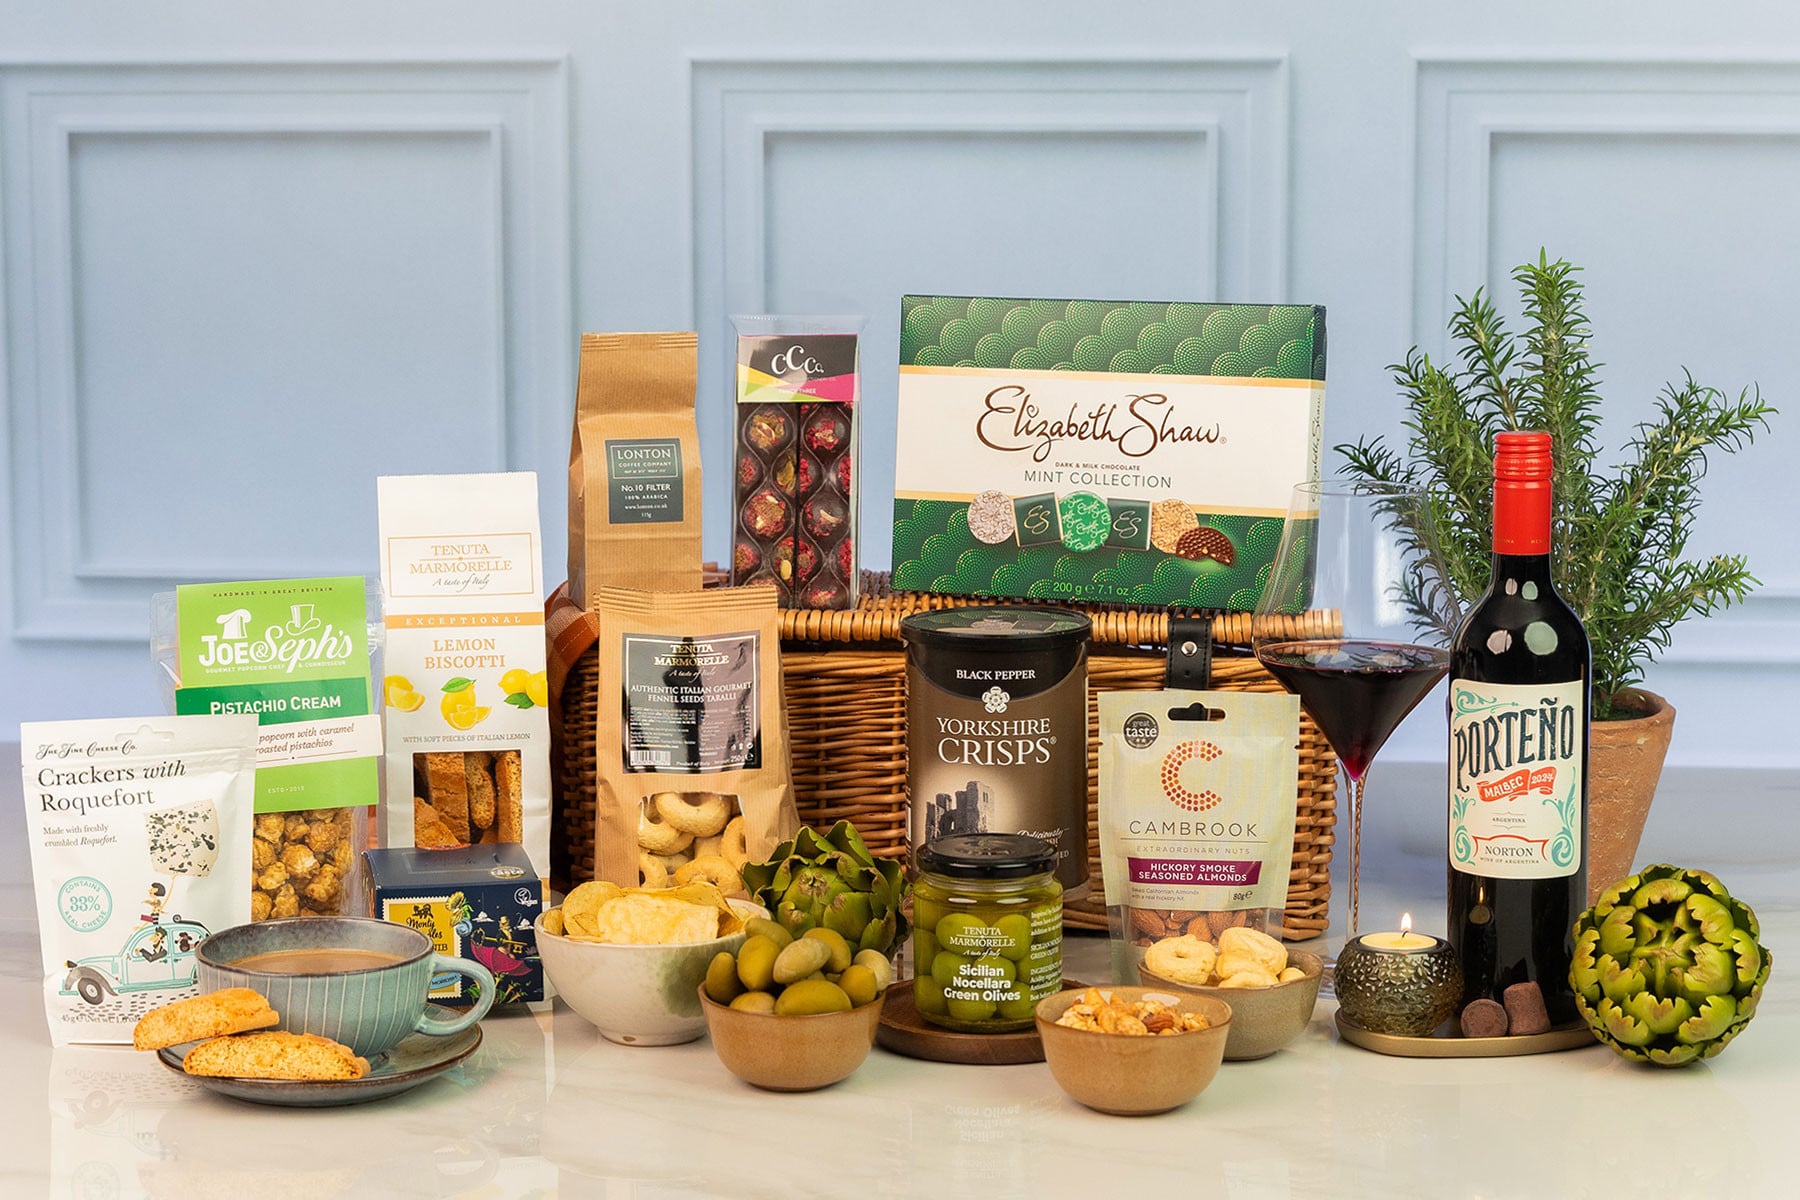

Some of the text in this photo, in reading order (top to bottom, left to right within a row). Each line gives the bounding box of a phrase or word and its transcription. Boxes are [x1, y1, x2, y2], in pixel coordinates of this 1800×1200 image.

[976, 385, 1221, 462] Elizabeth Shaw
[616, 448, 671, 460] LONTON
[1024, 470, 1172, 488] MINT COLLECTION
[646, 483, 671, 491] FILTER
[431, 544, 490, 556] TENUTA
[410, 560, 512, 574] MARMORELLE
[1053, 582, 1072, 593] 200
[1099, 584, 1113, 594] 7.1
[1116, 587, 1129, 596] oz
[406, 616, 521, 626] EXCEPTIONAL
[433, 638, 496, 652] LEMON
[670, 644, 714, 654] TENUTA
[424, 655, 506, 670] BISCOTTI
[654, 655, 730, 666] MARMORELLE
[956, 670, 1036, 680] BLACK PEPPER
[630, 682, 752, 694] AUTHENTIC ITALIAN GOURMET
[648, 693, 736, 703] FENNEL SEEDS TARALLI
[936, 716, 1051, 736] YORKSHIRE
[258, 723, 354, 745] popcorn with caramel
[476, 734, 504, 742] ITALIAN
[506, 732, 530, 740] LEMON
[1126, 728, 1157, 738] taste
[256, 739, 334, 754] roasted pistachios
[1454, 698, 1574, 792] PORTEÑO
[938, 738, 1051, 766] CRISPS
[38, 760, 187, 787] Crackers with
[1531, 772, 1554, 785] 2024
[1484, 776, 1524, 798] MALBEC
[40, 788, 156, 816] Roquefort
[43, 824, 108, 835] Made with freshly
[1129, 820, 1258, 838] CAMBROOK
[44, 838, 78, 847] crumbled
[1136, 845, 1220, 854] EXTRAORDINARY
[1485, 846, 1533, 856] NORTON
[1150, 863, 1236, 874] HICKORY SMOKE
[1138, 871, 1247, 882] SEASONED ALMONDS
[70, 895, 101, 912] 33%
[406, 916, 435, 931] Monty
[962, 926, 1002, 936] TENUTA
[950, 937, 1016, 947] MARMORELLE
[959, 964, 1004, 976] Sicilian
[952, 976, 1012, 989] Nocellara
[944, 988, 1020, 1002] Green Olives
